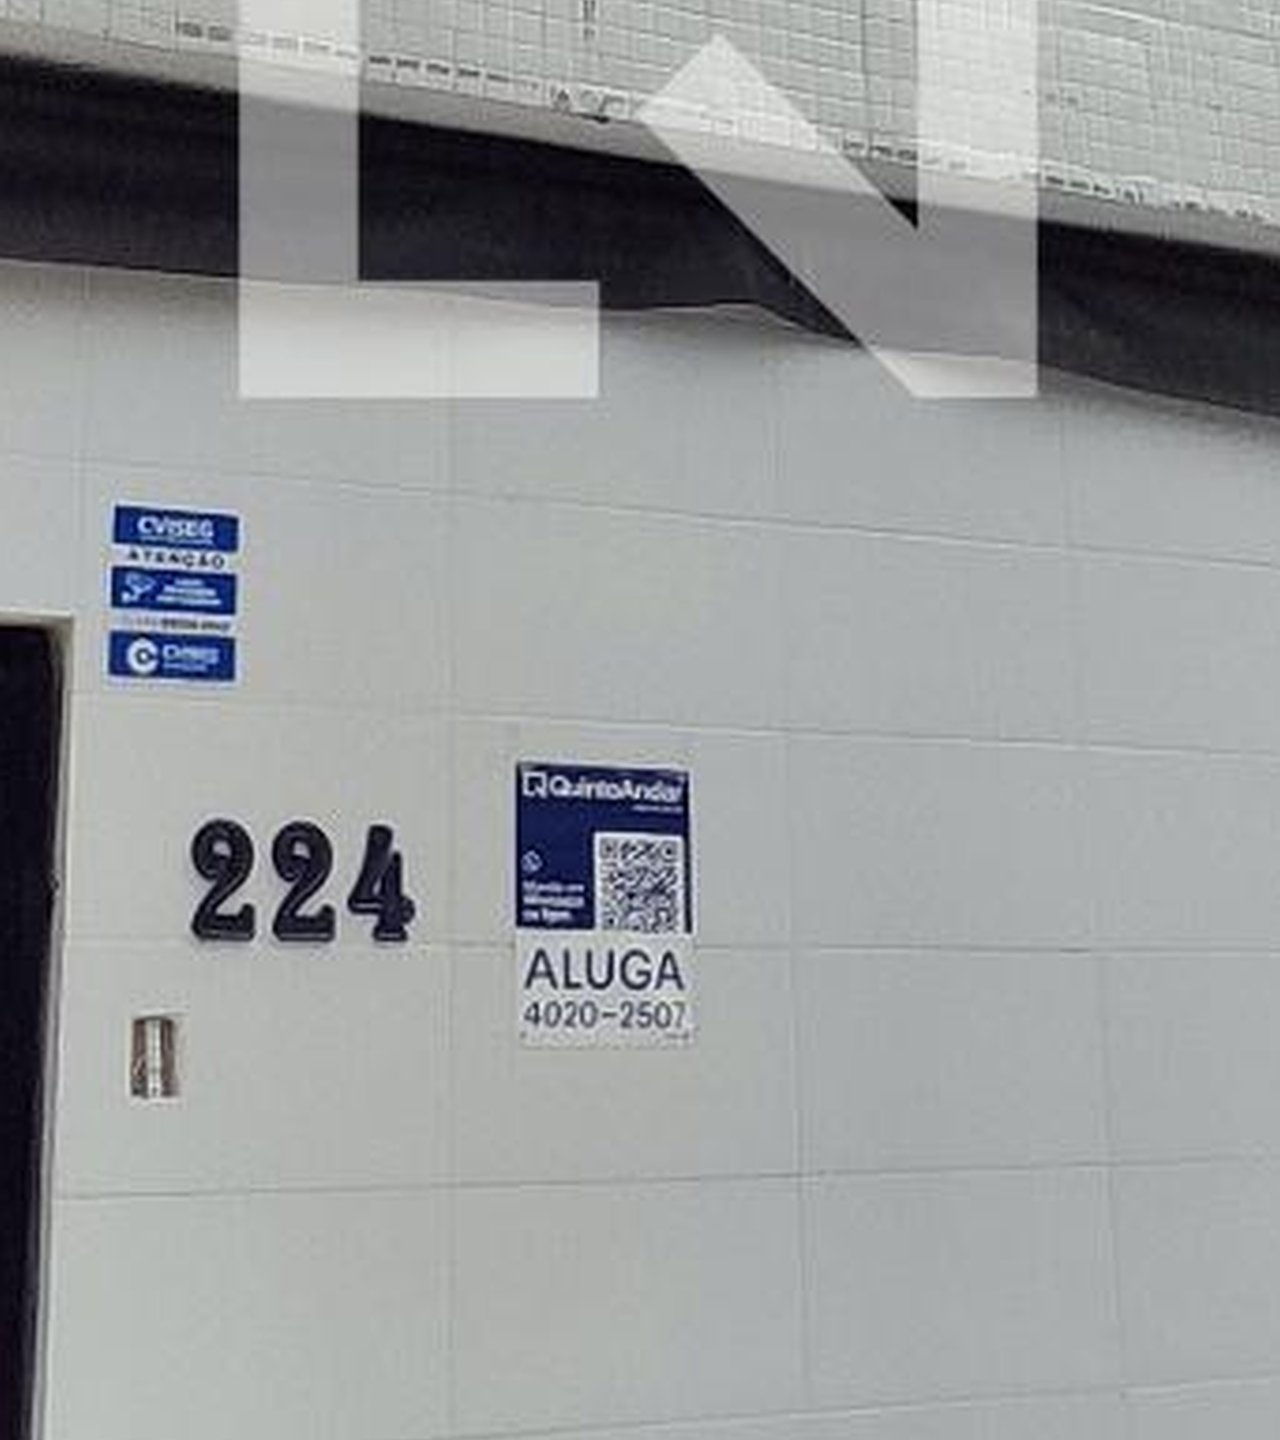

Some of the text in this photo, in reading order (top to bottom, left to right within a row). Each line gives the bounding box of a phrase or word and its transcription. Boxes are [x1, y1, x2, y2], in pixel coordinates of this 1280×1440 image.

[130, 549, 225, 569] ATENÇÃO
[548, 775, 684, 801] QuintoAndar
[191, 818, 416, 942] 224
[524, 949, 684, 991] ALUGA
[523, 1000, 687, 1030] 4020-2507
